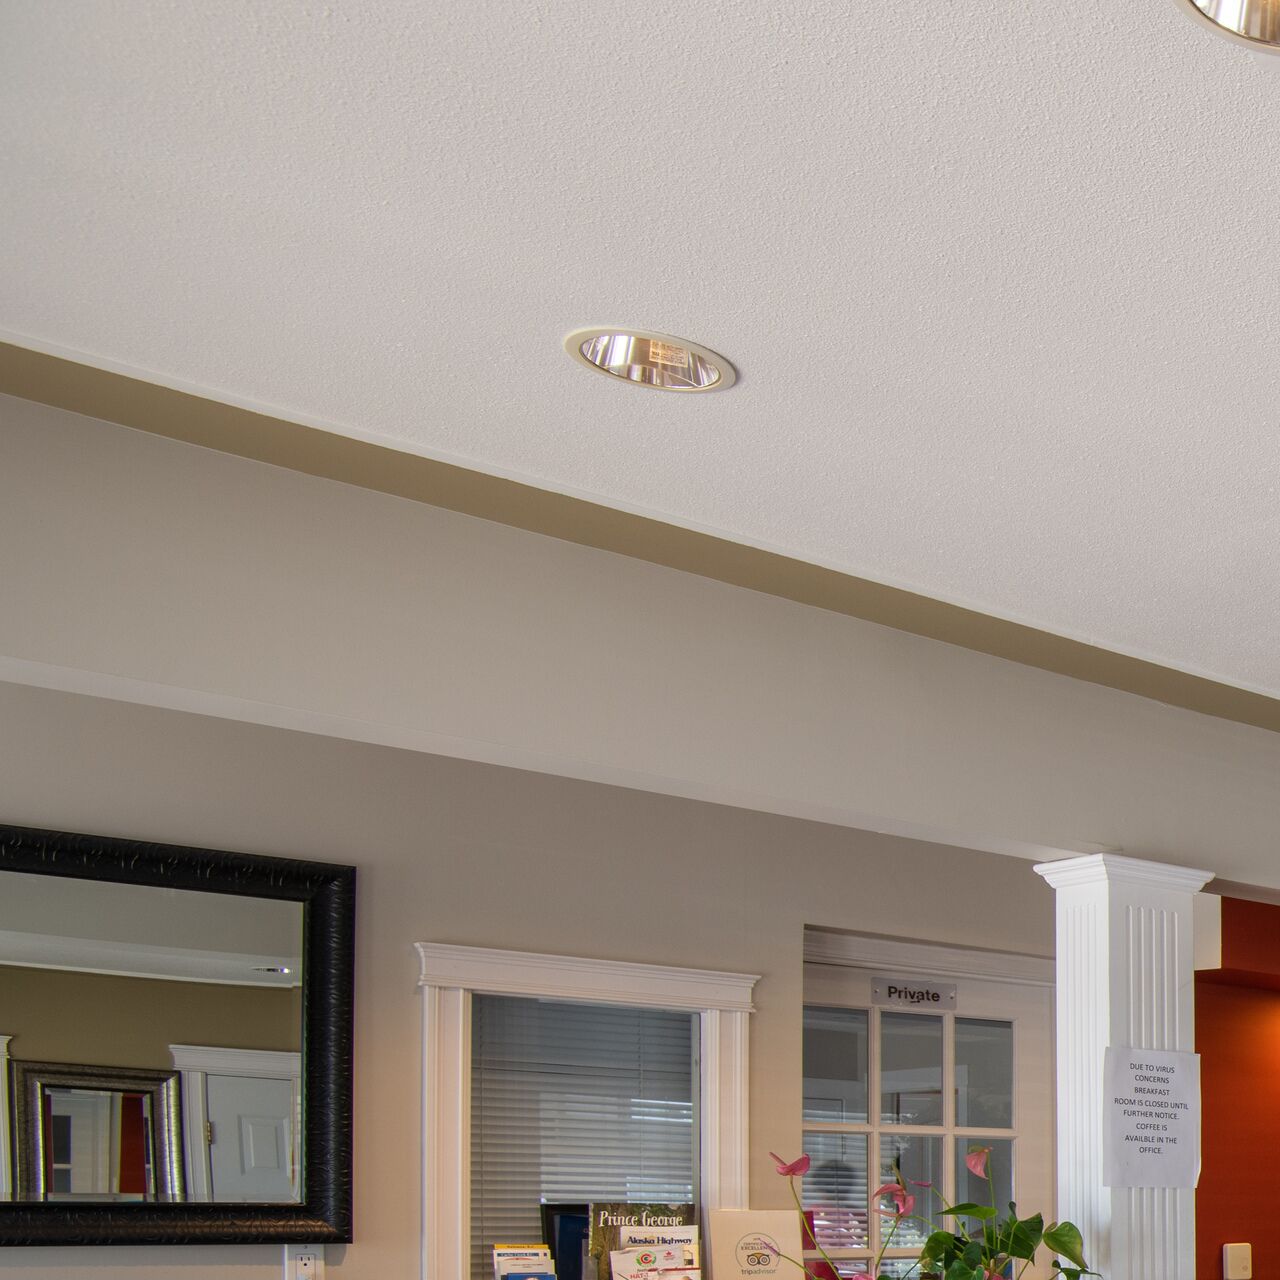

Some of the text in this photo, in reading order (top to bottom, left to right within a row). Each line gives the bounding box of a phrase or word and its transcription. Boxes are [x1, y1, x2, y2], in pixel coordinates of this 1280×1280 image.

[888, 986, 940, 1002] Private
[1130, 1063, 1144, 1071] DUE
[1156, 1065, 1175, 1074] VIRUS
[1134, 1075, 1170, 1084] CONCERNS
[1134, 1087, 1170, 1096] BREAKFAST
[1144, 1100, 1169, 1108] CLOSED
[1170, 1101, 1189, 1110] UNTIL
[1123, 1110, 1180, 1120] FURTHER NOTICE.
[1125, 1135, 1155, 1143] AVAILBLE
[599, 1210, 683, 1227] Prince George
[657, 1237, 692, 1245] Highway
